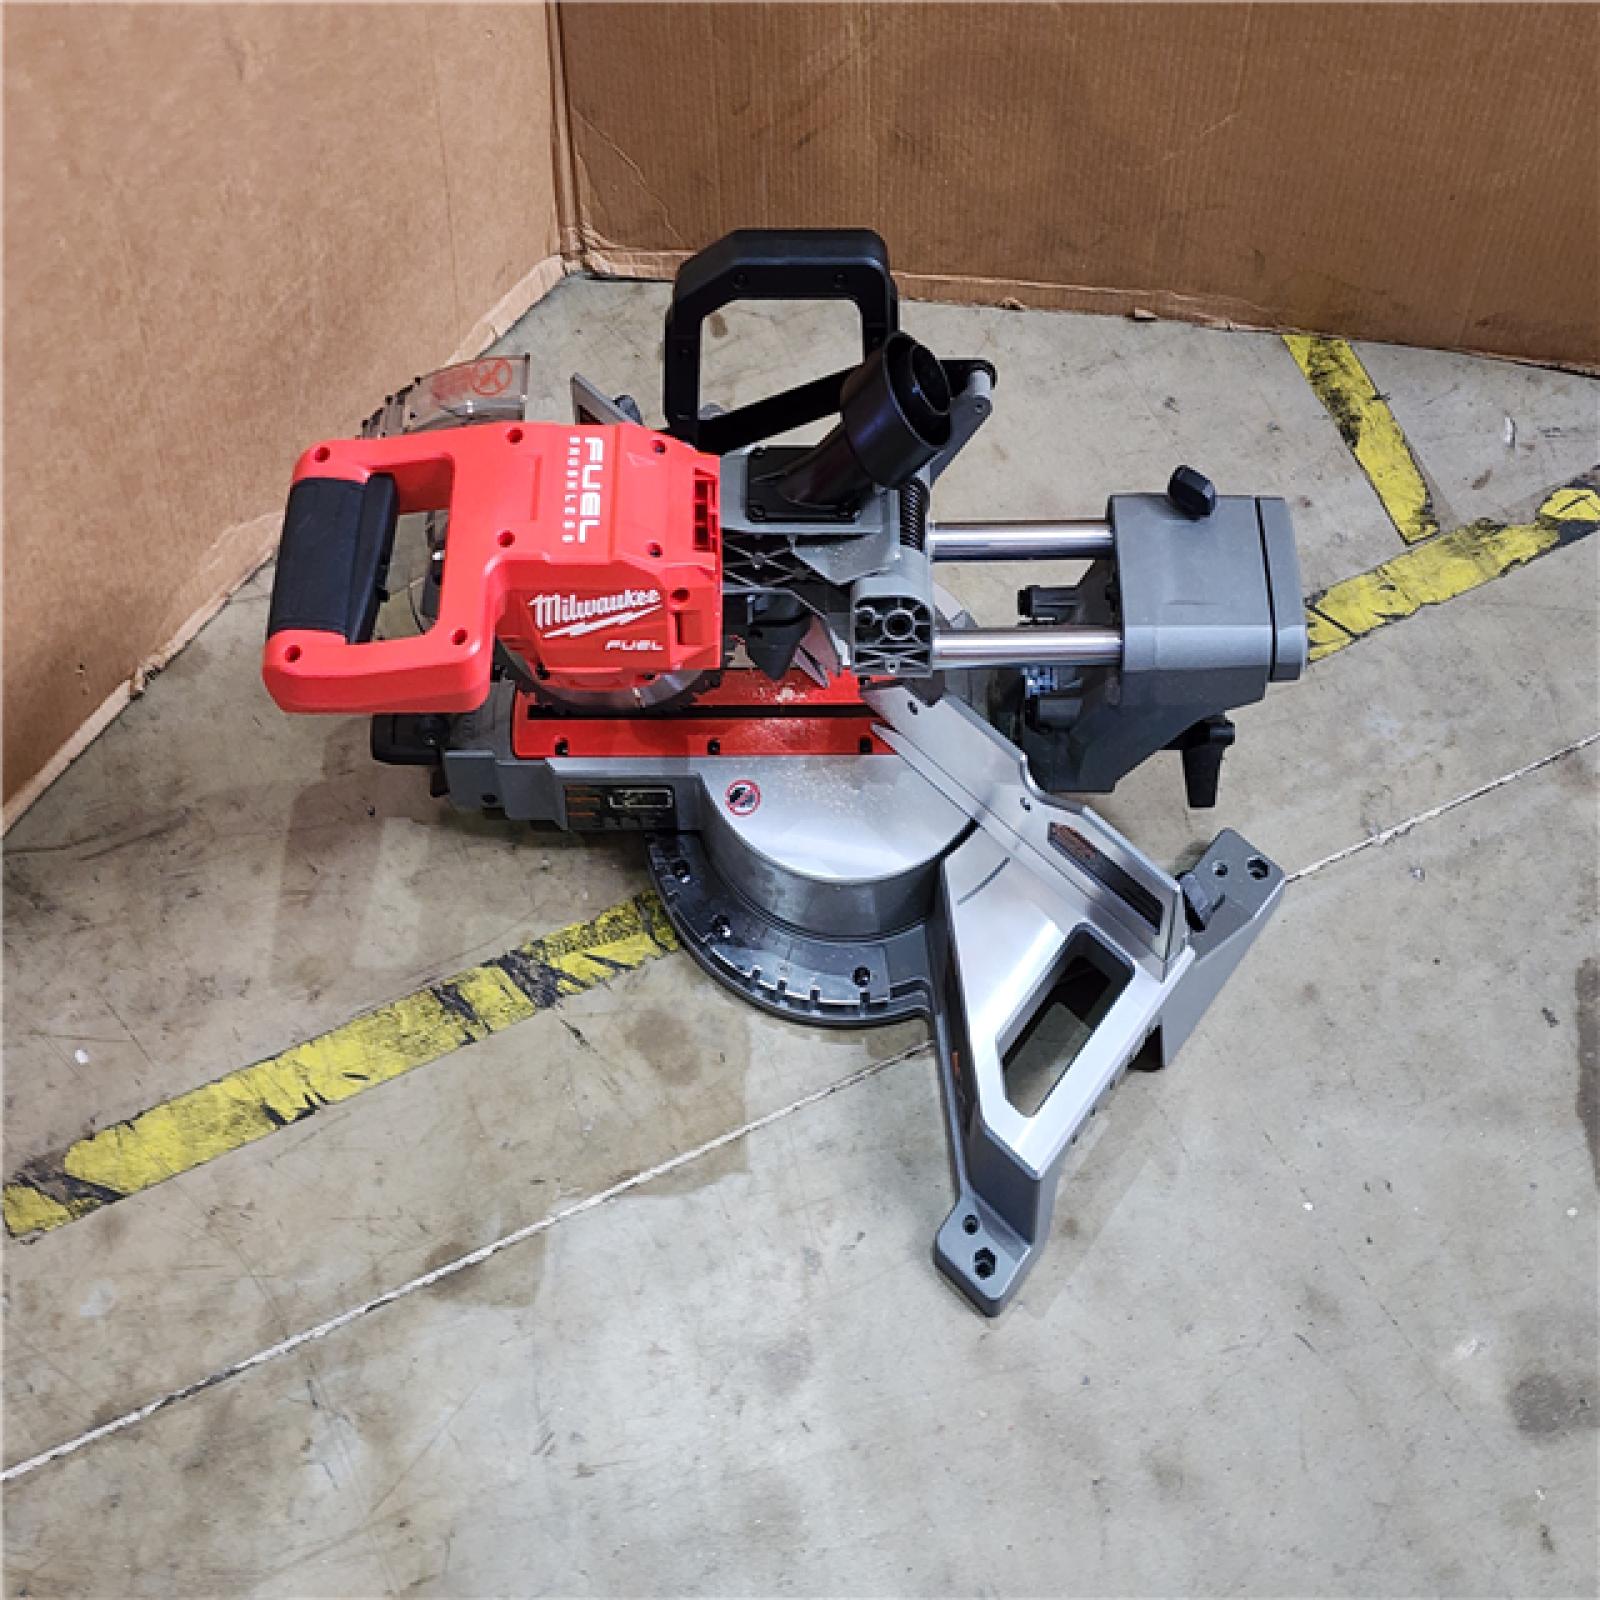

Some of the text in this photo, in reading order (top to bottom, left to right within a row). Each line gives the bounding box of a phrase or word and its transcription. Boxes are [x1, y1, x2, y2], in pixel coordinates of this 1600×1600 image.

[578, 437, 603, 543] FUEL
[528, 589, 661, 630] Milwaukee
[604, 639, 664, 651] FUEL
